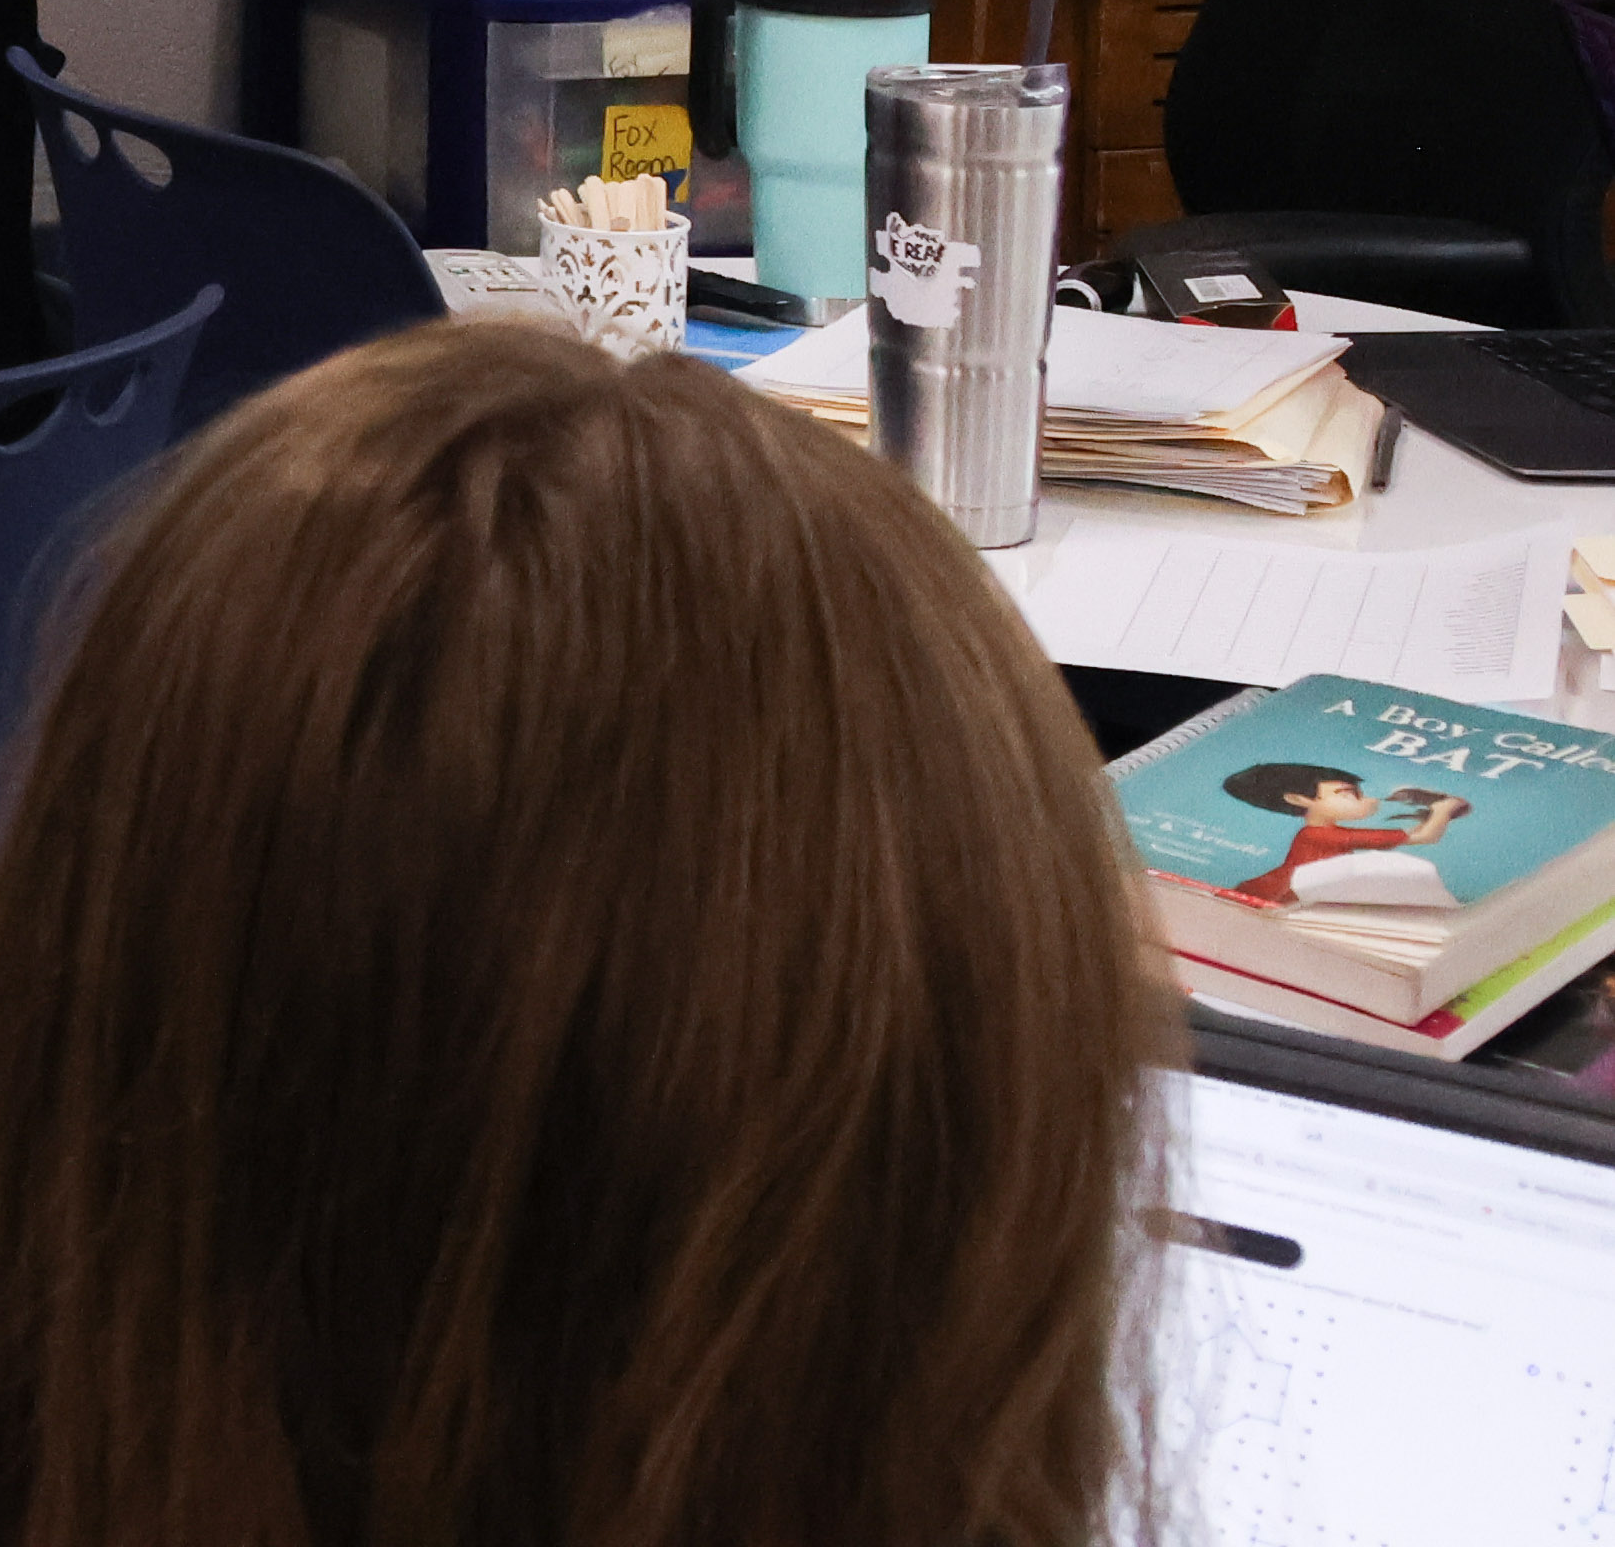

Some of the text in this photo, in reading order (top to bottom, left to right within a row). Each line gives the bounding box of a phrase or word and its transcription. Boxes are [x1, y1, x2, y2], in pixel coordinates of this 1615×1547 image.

[613, 114, 658, 151] Fox
[609, 151, 677, 180] Room
[1324, 699, 1357, 716] A
[1377, 704, 1485, 741] Boy
[1364, 729, 1546, 779] BAT
